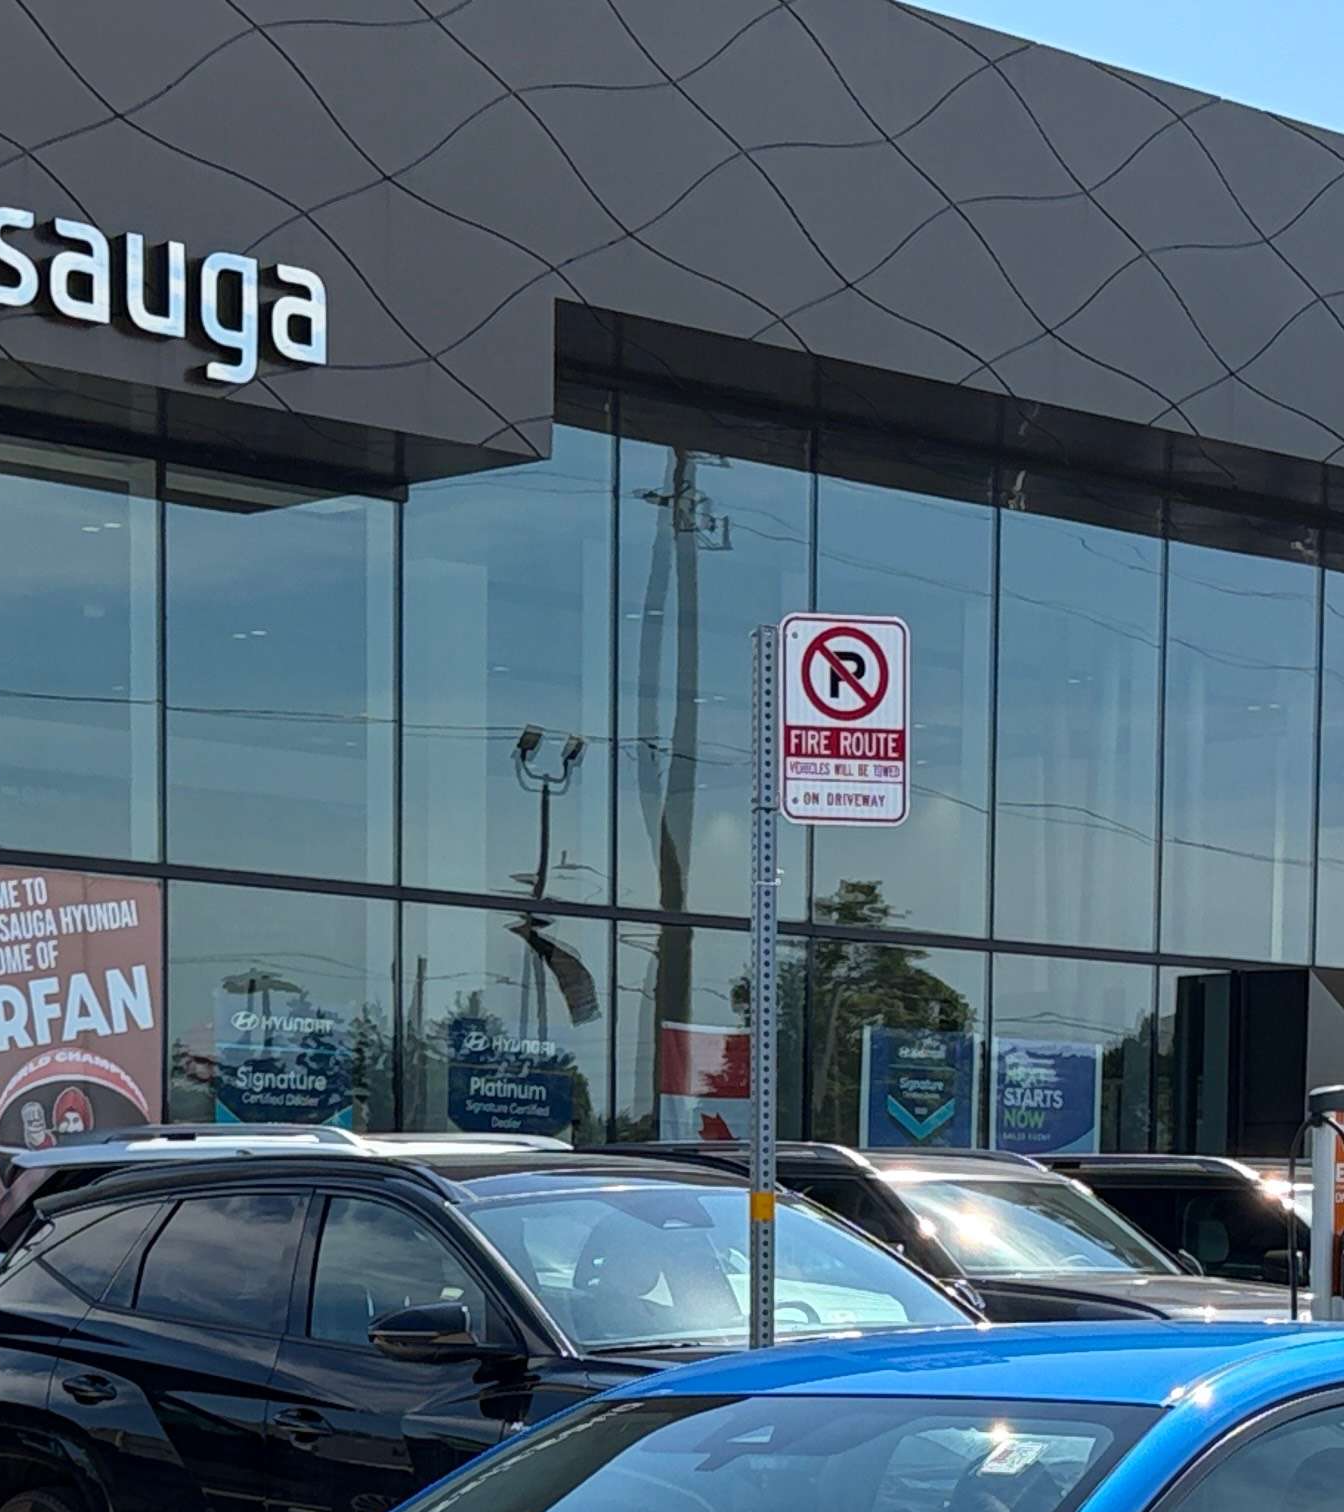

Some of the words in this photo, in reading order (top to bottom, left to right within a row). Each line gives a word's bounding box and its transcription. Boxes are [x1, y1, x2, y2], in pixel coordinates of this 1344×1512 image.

[790, 729, 831, 755] FIRE
[839, 732, 899, 757] ROUTE
[789, 761, 830, 776] VEHICLES
[834, 763, 854, 777] WILL
[858, 764, 869, 777] BE
[873, 764, 900, 778] TOWED
[803, 792, 820, 806] ON
[827, 792, 885, 808] DRIVEWAY
[22, 877, 48, 906] TO
[59, 900, 139, 935] HYUNDAI
[36, 940, 58, 969] OF
[236, 1065, 327, 1091] Signature
[469, 1076, 546, 1101] Platinum
[465, 1100, 508, 1114] Signature
[1003, 1087, 1064, 1109] STARTS
[1004, 1108, 1045, 1129] NOW
